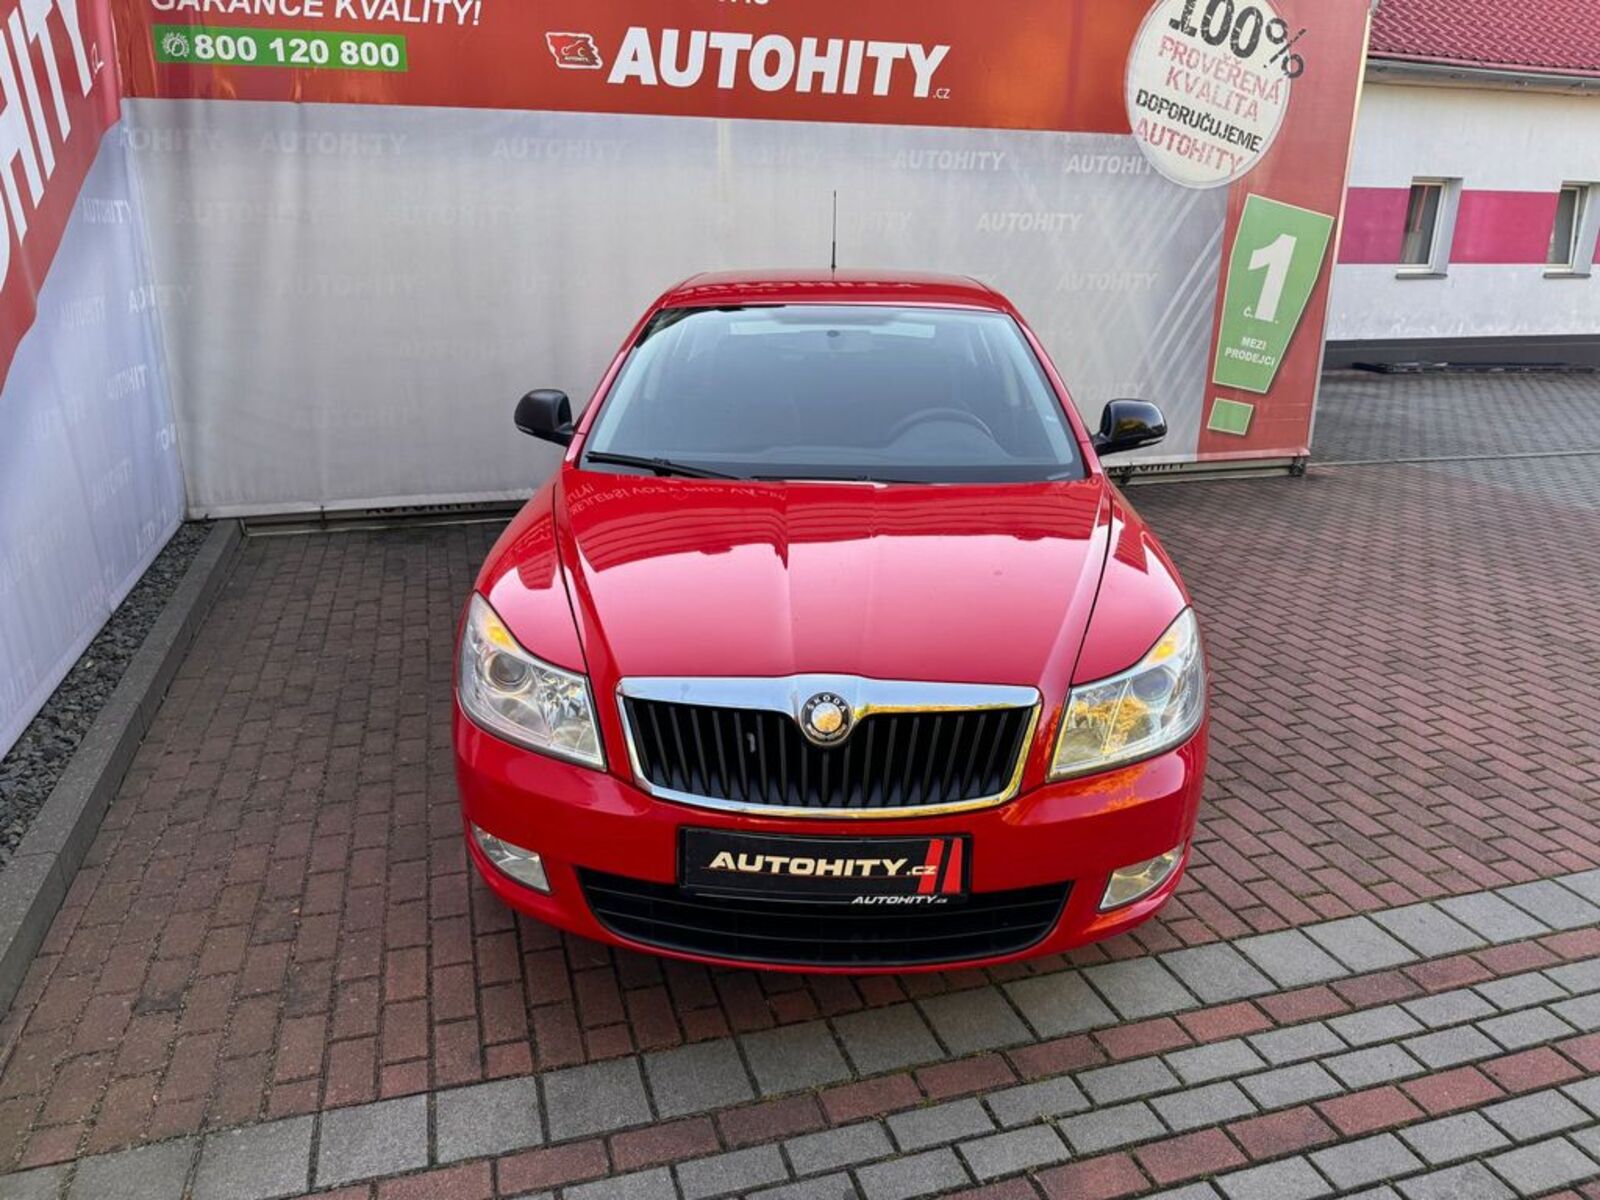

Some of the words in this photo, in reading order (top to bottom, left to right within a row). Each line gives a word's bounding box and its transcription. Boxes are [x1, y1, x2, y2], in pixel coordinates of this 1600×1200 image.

[335, 0, 482, 26] KVALITY!
[195, 34, 258, 62] 800
[269, 37, 330, 65] 120
[340, 40, 400, 67] 800
[1169, 0, 1306, 79] 100%
[1159, 35, 1283, 105] PROVĚŘENÁ
[1165, 67, 1259, 122] KVALITA
[1136, 89, 1263, 153] DOPORUČUJEME
[892, 149, 1006, 172] AUTOHITY
[1135, 117, 1243, 176] AUTOHITY
[976, 212, 1083, 233] AUTOHITY
[1241, 336, 1267, 350] MEZI
